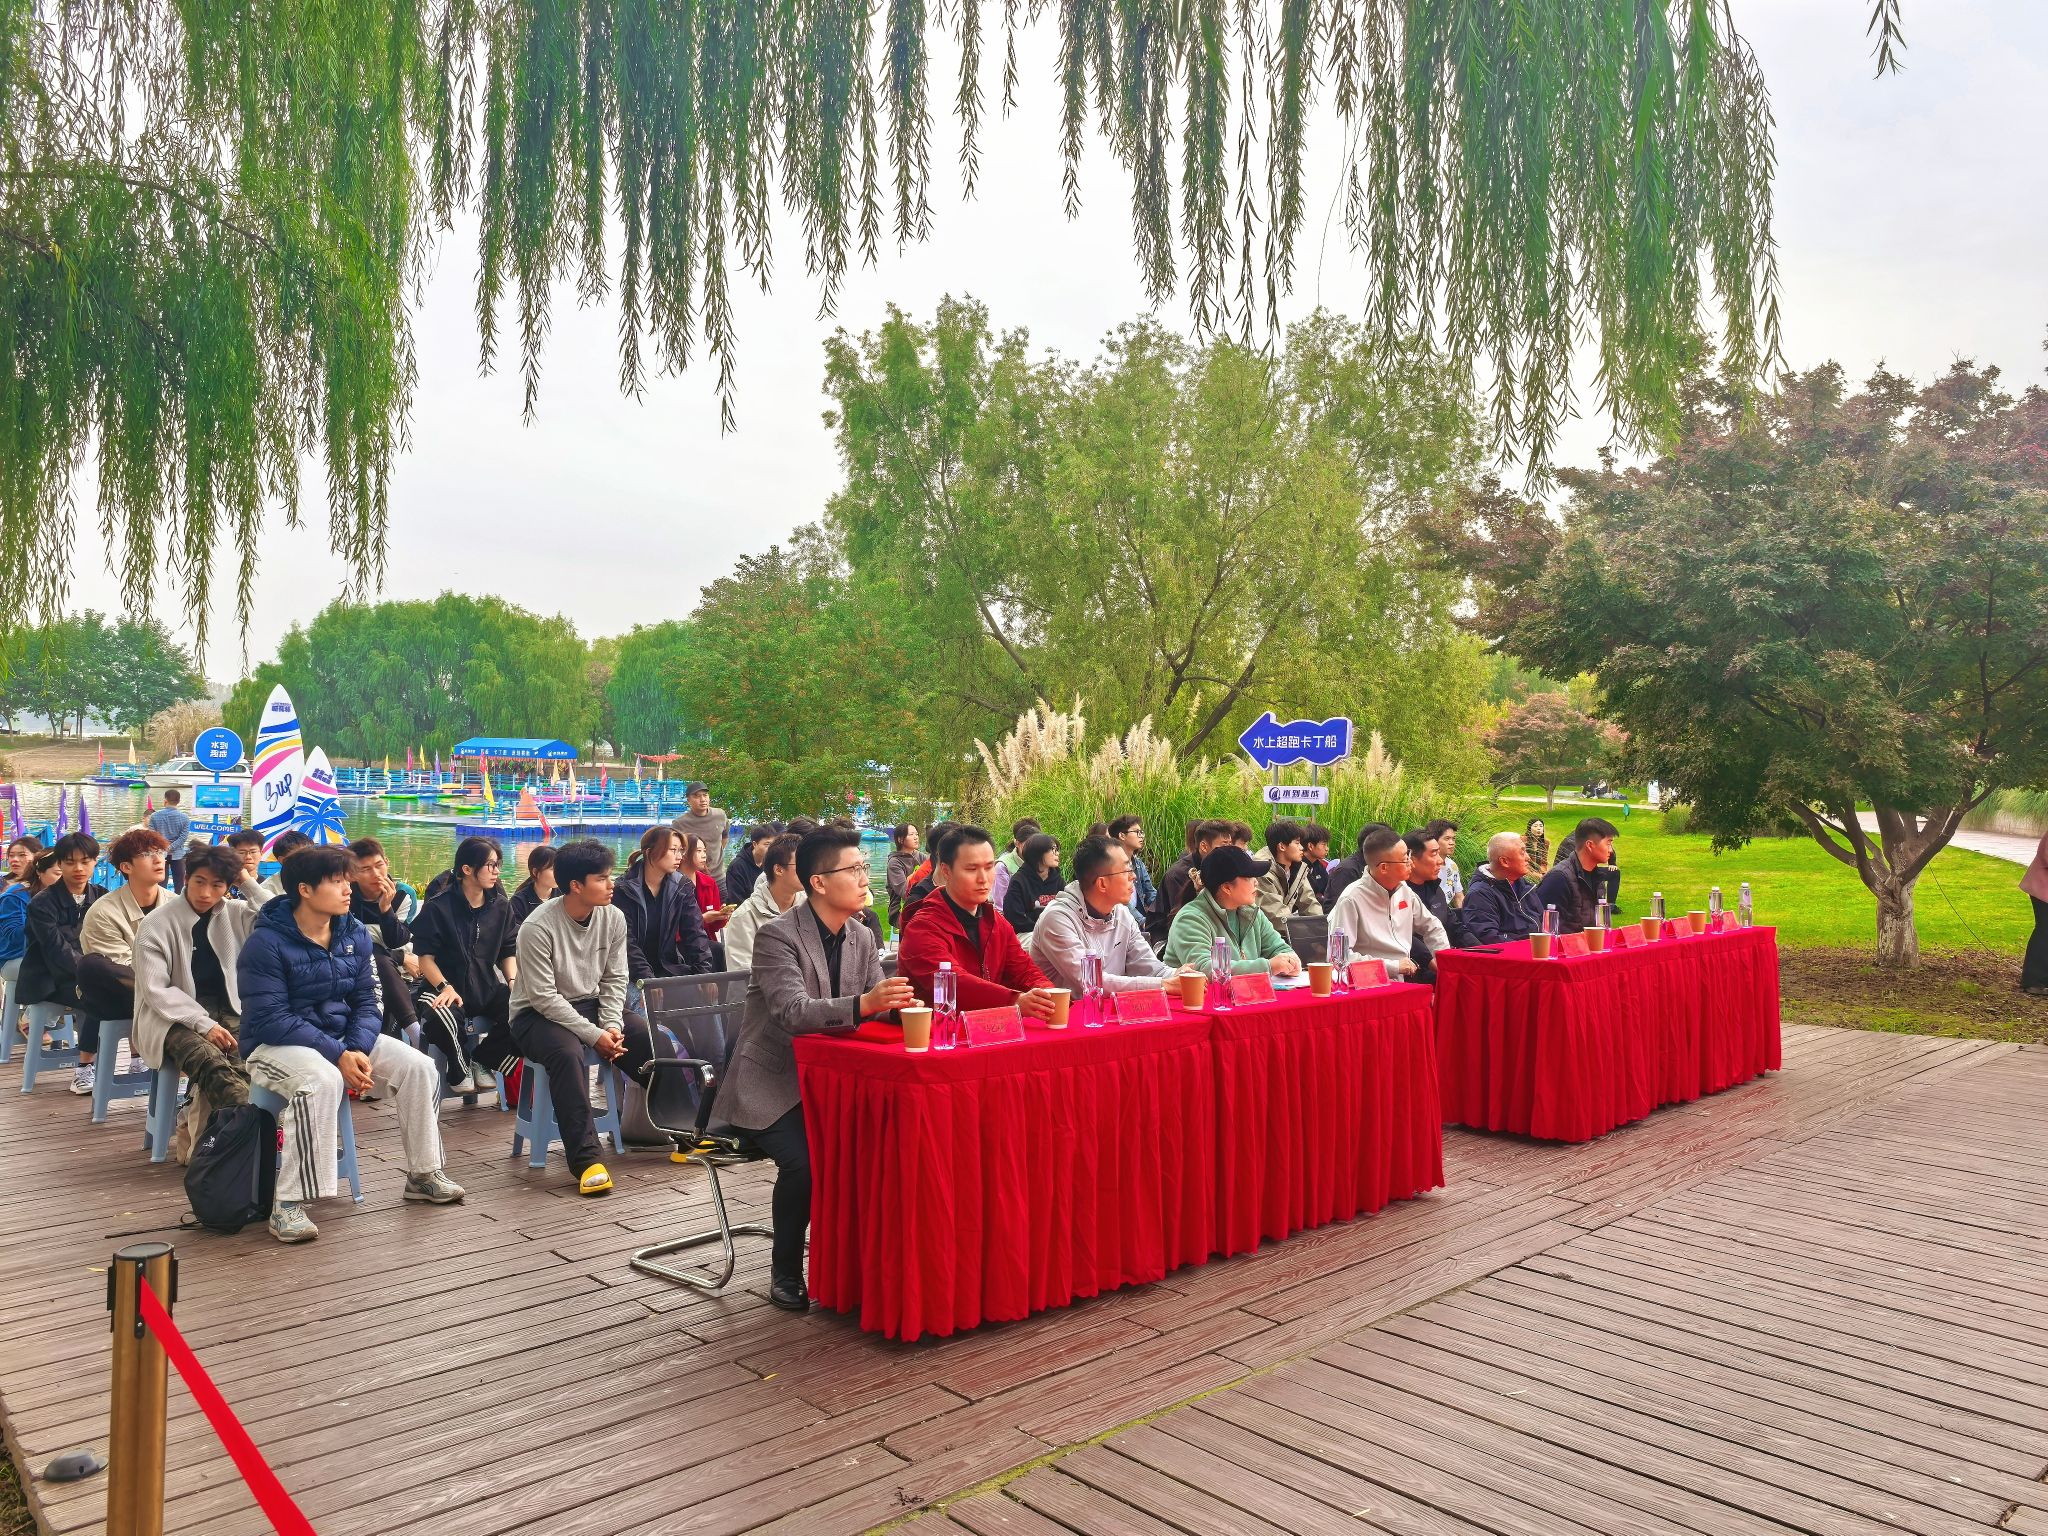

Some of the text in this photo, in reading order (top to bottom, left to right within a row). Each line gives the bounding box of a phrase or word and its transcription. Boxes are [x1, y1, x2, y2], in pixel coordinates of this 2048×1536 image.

[1253, 735, 1337, 749] 水上超跑卡丁船
